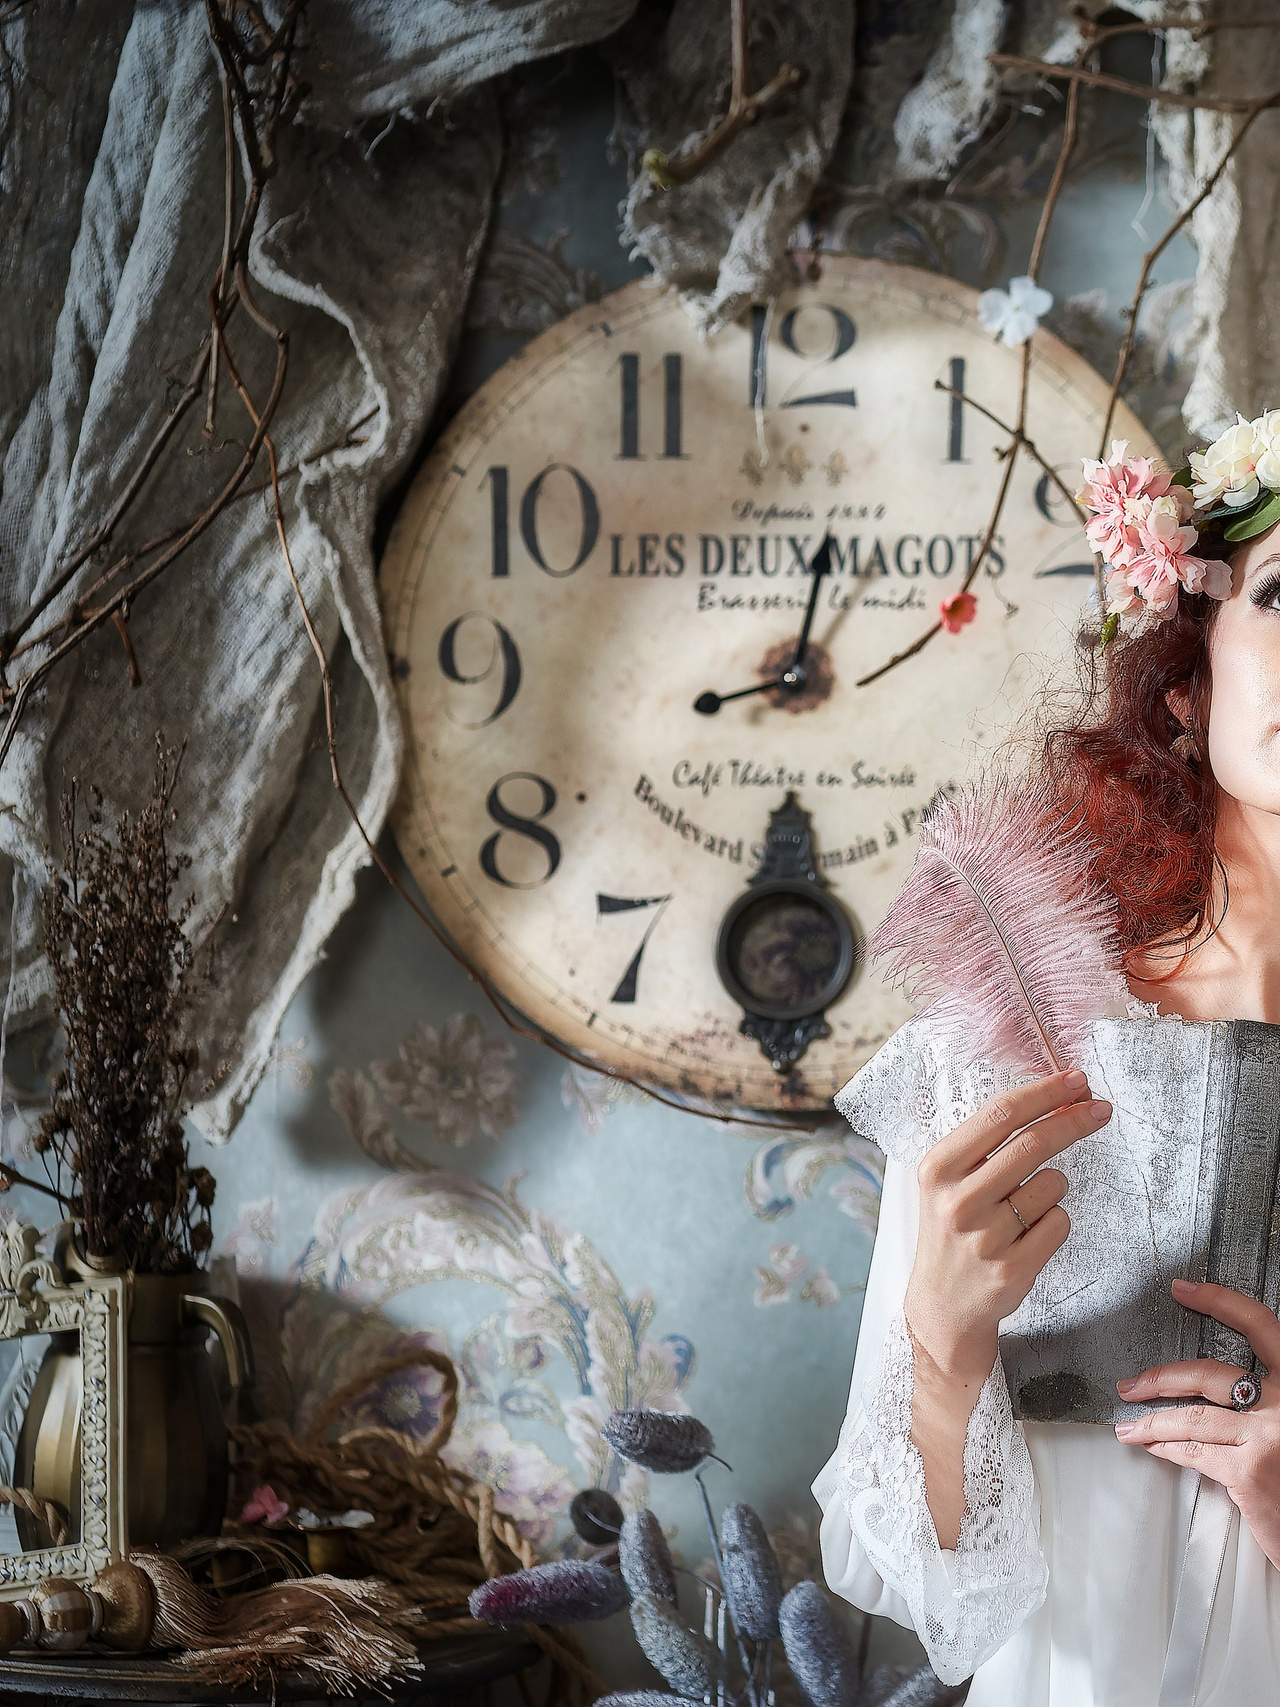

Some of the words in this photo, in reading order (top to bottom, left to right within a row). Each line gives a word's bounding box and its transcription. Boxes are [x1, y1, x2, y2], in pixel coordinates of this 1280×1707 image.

[606, 352, 694, 462] 11
[748, 301, 858, 411] 12
[935, 355, 973, 466] 1
[476, 461, 601, 580] 10
[608, 532, 686, 579] LES
[699, 532, 816, 579] DEUX
[826, 531, 1007, 580] MAGOTS
[698, 581, 810, 613] Brasseri
[437, 609, 523, 730] 9
[478, 770, 563, 891] 8
[634, 772, 744, 866] Boulevard
[671, 758, 724, 800] Café
[816, 769, 843, 788] en
[595, 891, 674, 1005] 7
